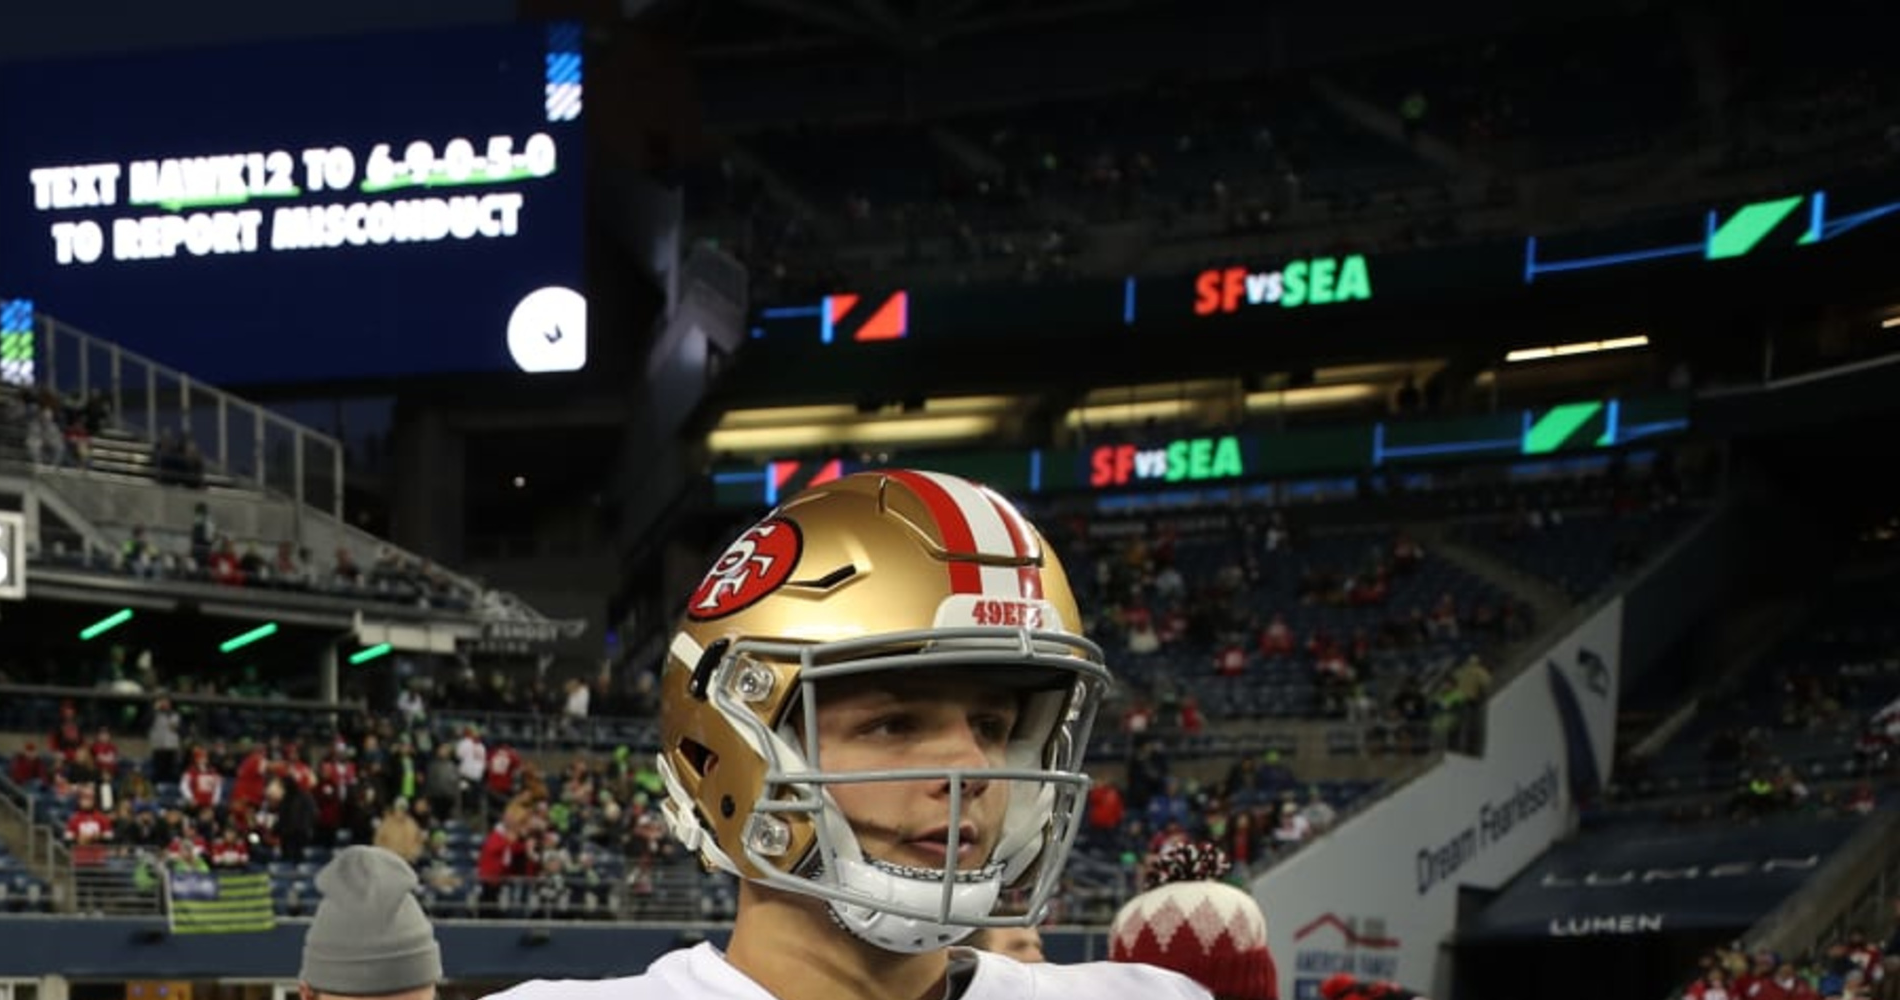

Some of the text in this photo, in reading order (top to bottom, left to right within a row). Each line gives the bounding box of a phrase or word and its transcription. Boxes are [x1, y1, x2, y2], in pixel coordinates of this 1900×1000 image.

[30, 133, 557, 210] TEXT HAWK12 TO 6-9-0-5-0
[52, 194, 523, 264] TO REPORT MISCONDUCT
[1417, 764, 1560, 896] Dream Fearlessly
[1550, 914, 1664, 936] LUMEN
